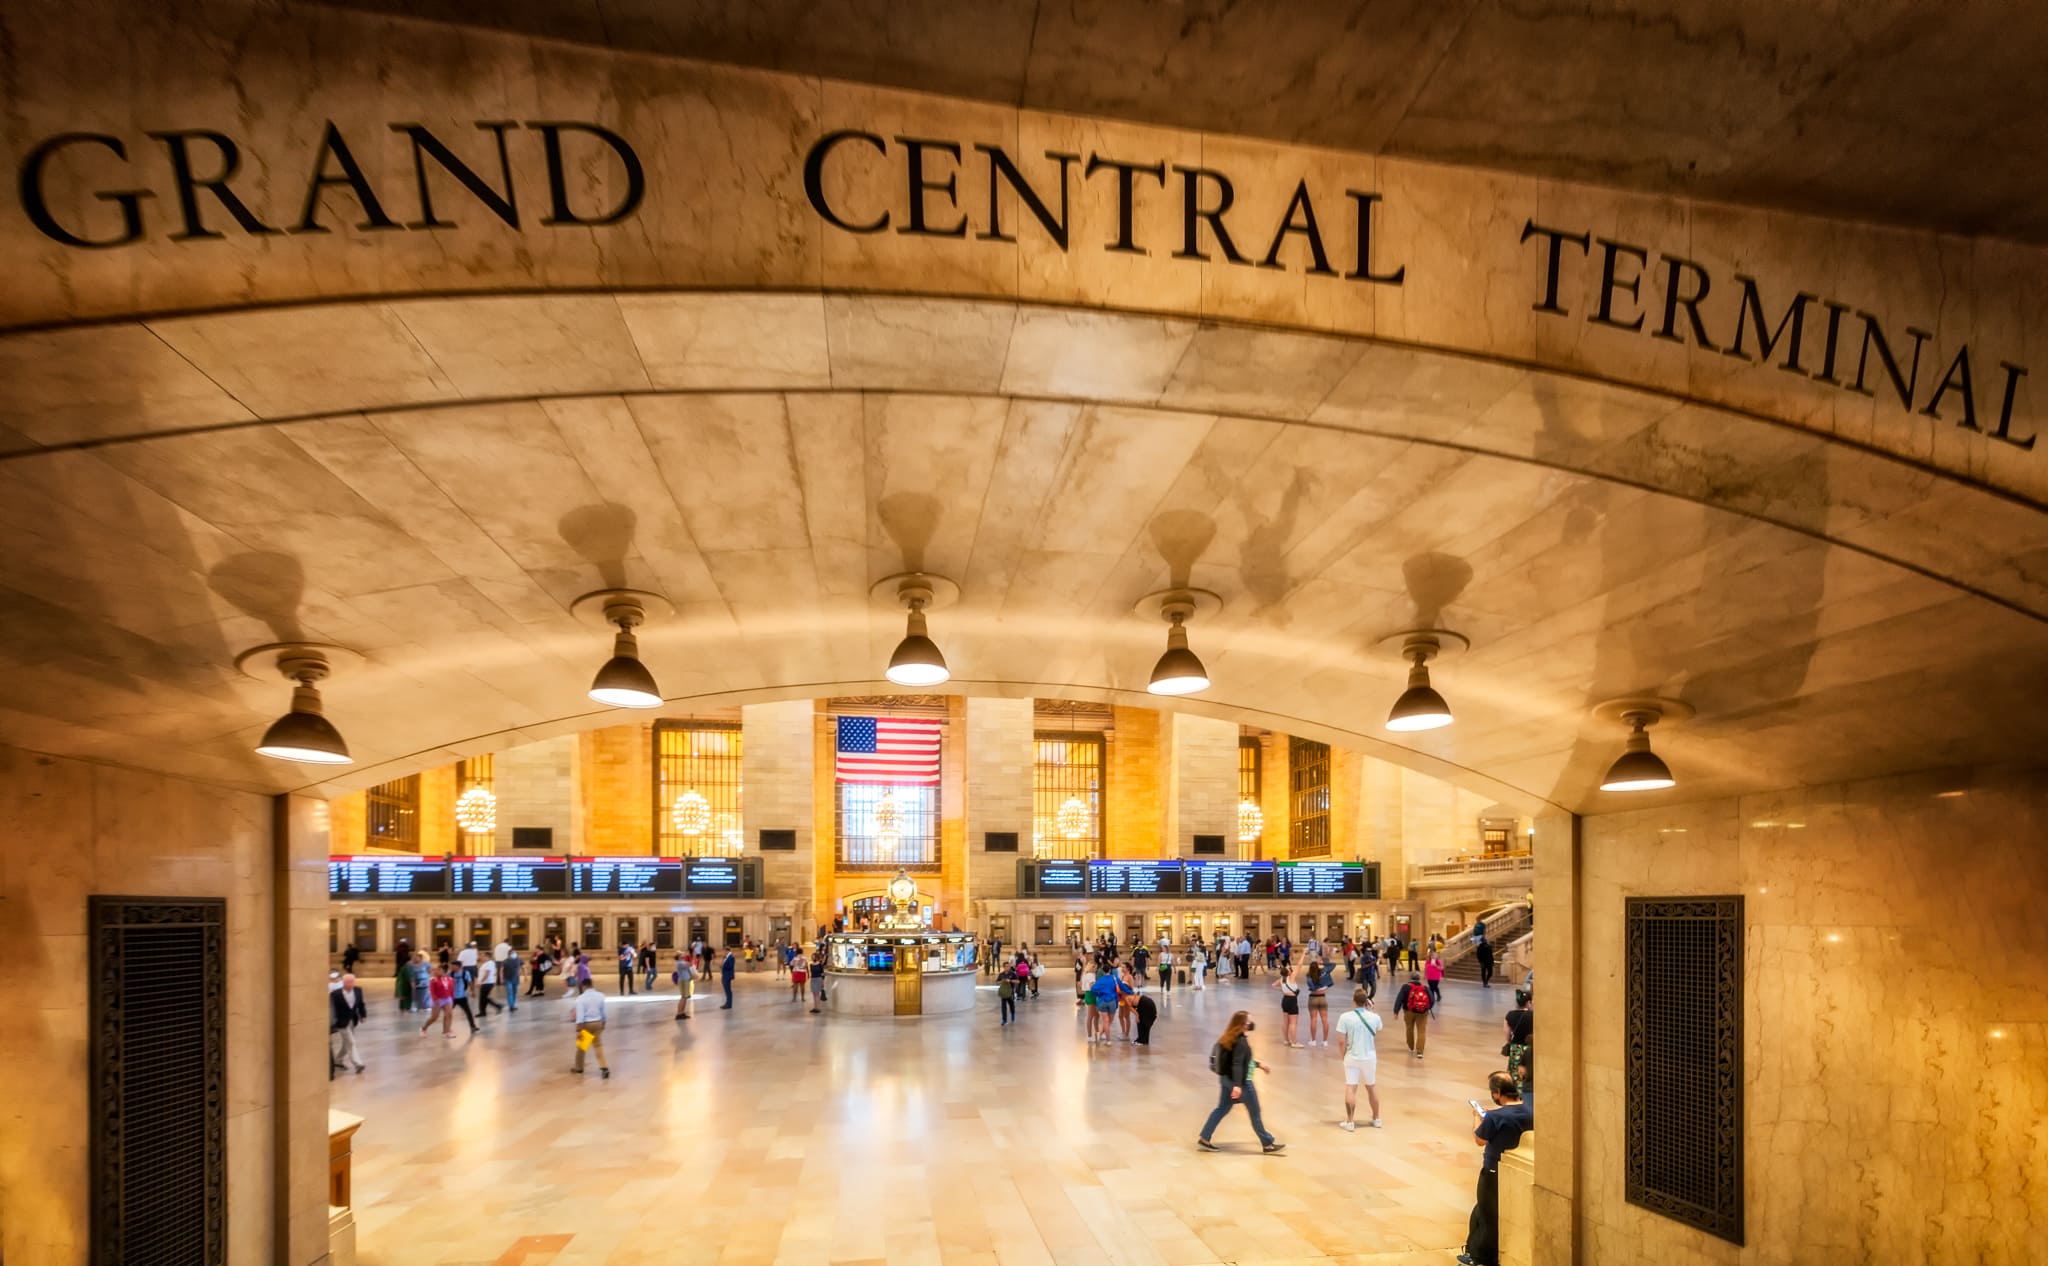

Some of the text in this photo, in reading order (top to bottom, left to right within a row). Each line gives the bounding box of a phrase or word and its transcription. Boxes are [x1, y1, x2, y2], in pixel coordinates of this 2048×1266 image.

[17, 119, 2036, 451] GRAND CENTRAL TERMINAL
